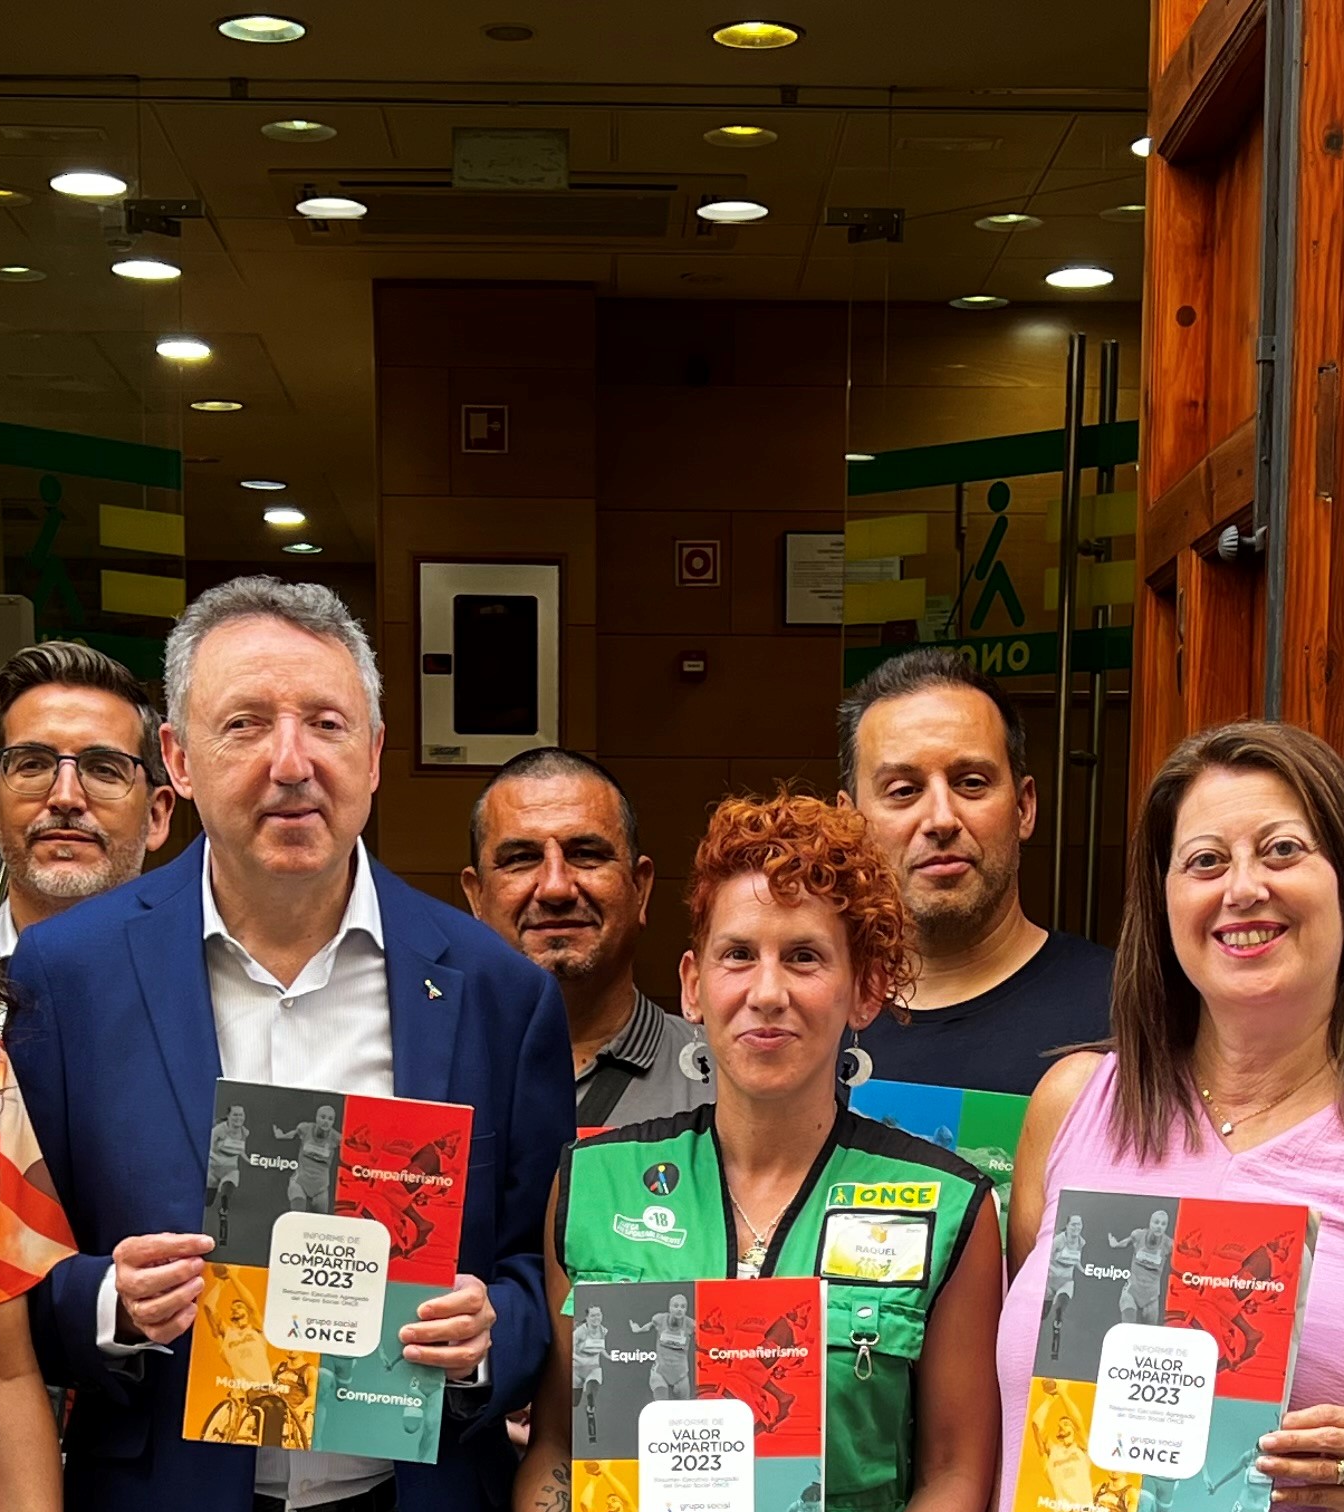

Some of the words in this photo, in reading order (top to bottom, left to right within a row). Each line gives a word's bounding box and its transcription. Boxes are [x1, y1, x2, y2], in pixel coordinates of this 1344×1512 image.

[250, 1153, 299, 1171] Equipo
[352, 1165, 454, 1188] Compañerismo
[860, 1187, 932, 1204] ONCE
[305, 1242, 356, 1258] VALOR
[855, 1244, 897, 1256] RAQUEL
[279, 1252, 379, 1274] COMPARTIDO
[301, 1268, 354, 1289] 2023
[1084, 1264, 1131, 1281] Equipo
[1181, 1273, 1285, 1293] Compañerismo
[306, 1318, 332, 1327] grupo
[305, 1328, 356, 1344] ONCE
[611, 1349, 657, 1364] Equipo
[709, 1345, 809, 1361] Compañerismo
[1135, 1356, 1183, 1371] VALOR
[1108, 1367, 1205, 1388] COMPARTIDO
[336, 1388, 422, 1408] Compromiso
[1128, 1383, 1180, 1405] 2023
[672, 1429, 721, 1441] VALOR
[1130, 1436, 1156, 1445] grupo
[648, 1440, 745, 1454] COMPARTIDO
[1129, 1446, 1180, 1464] ONCE
[671, 1454, 722, 1471] 2023
[679, 1503, 705, 1511] grupo
